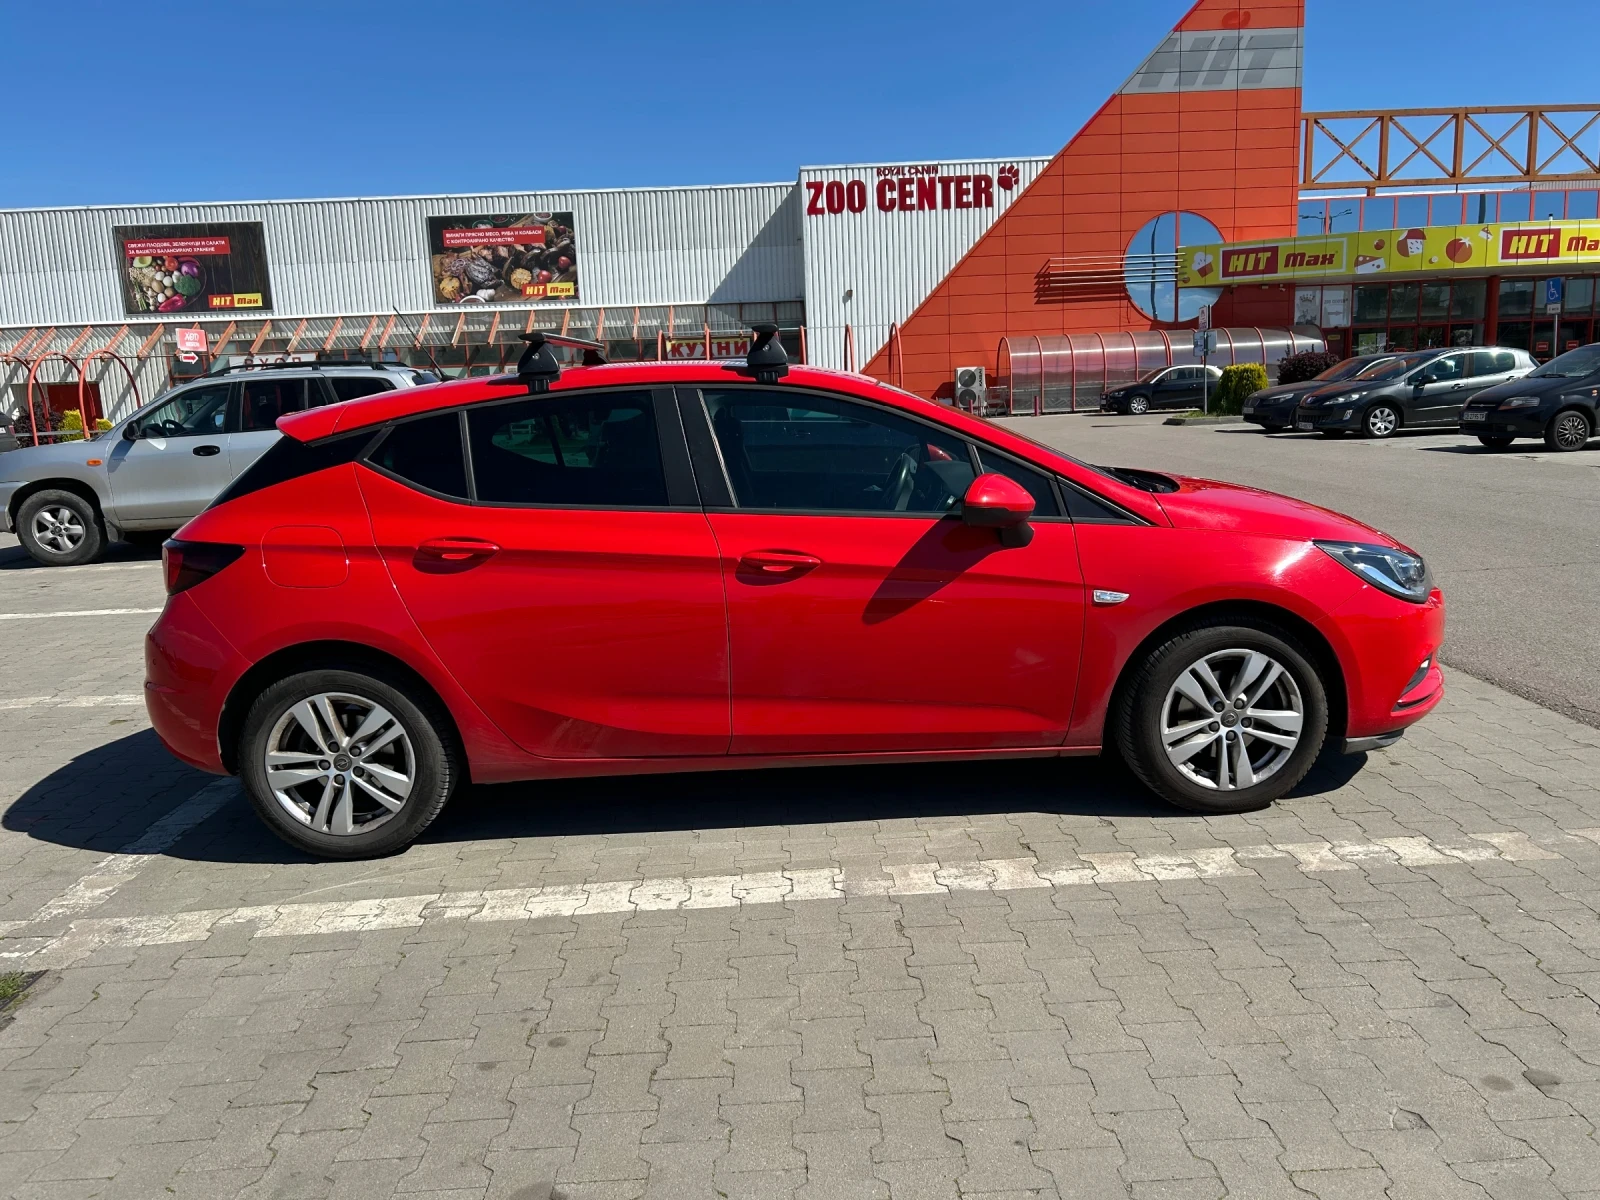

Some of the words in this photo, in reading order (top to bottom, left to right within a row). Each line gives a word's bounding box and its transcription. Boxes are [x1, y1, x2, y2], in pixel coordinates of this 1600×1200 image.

[876, 165, 906, 176] ROYAL
[907, 164, 938, 175] CANIN
[805, 180, 867, 216] ZOO
[876, 174, 994, 213] CENTER
[1508, 234, 1555, 254] HIT
[1566, 236, 1600, 252] Ma
[1228, 251, 1272, 273] HIT
[1283, 252, 1336, 268] Max
[525, 286, 545, 295] HIT
[212, 297, 232, 306] HIT
[670, 340, 748, 358] КУХНИ
